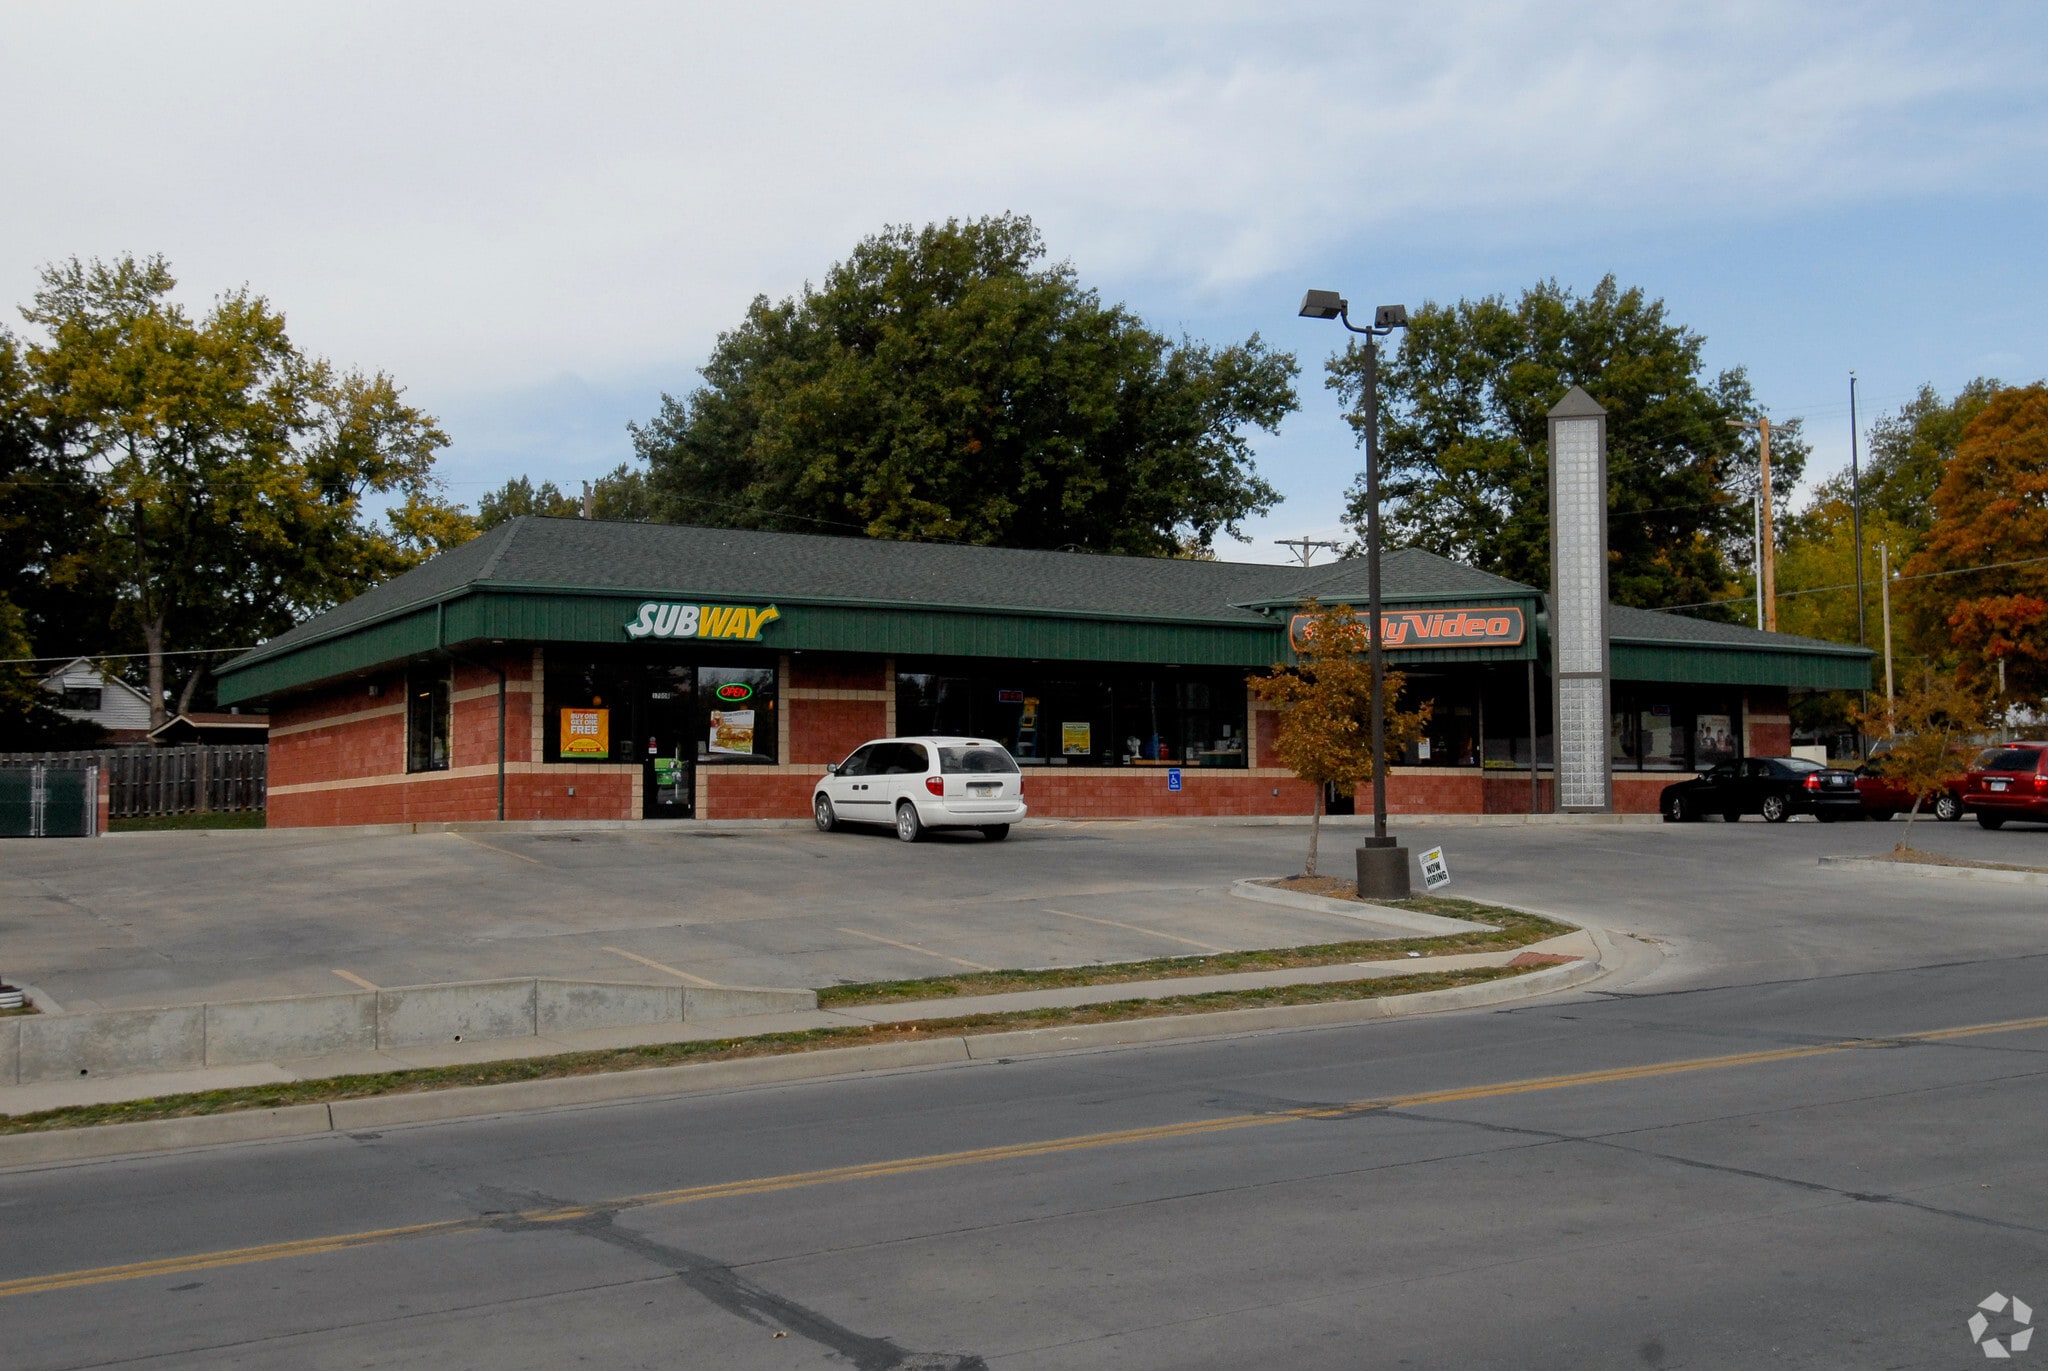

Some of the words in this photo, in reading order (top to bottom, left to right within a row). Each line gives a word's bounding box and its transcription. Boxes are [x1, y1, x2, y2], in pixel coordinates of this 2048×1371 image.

[628, 603, 780, 639] SUBWAY
[1403, 613, 1510, 638] Video
[720, 686, 748, 698] OPEN
[570, 725, 599, 735] FREE
[1426, 861, 1441, 875] NOW
[1426, 870, 1447, 886] HIRING
